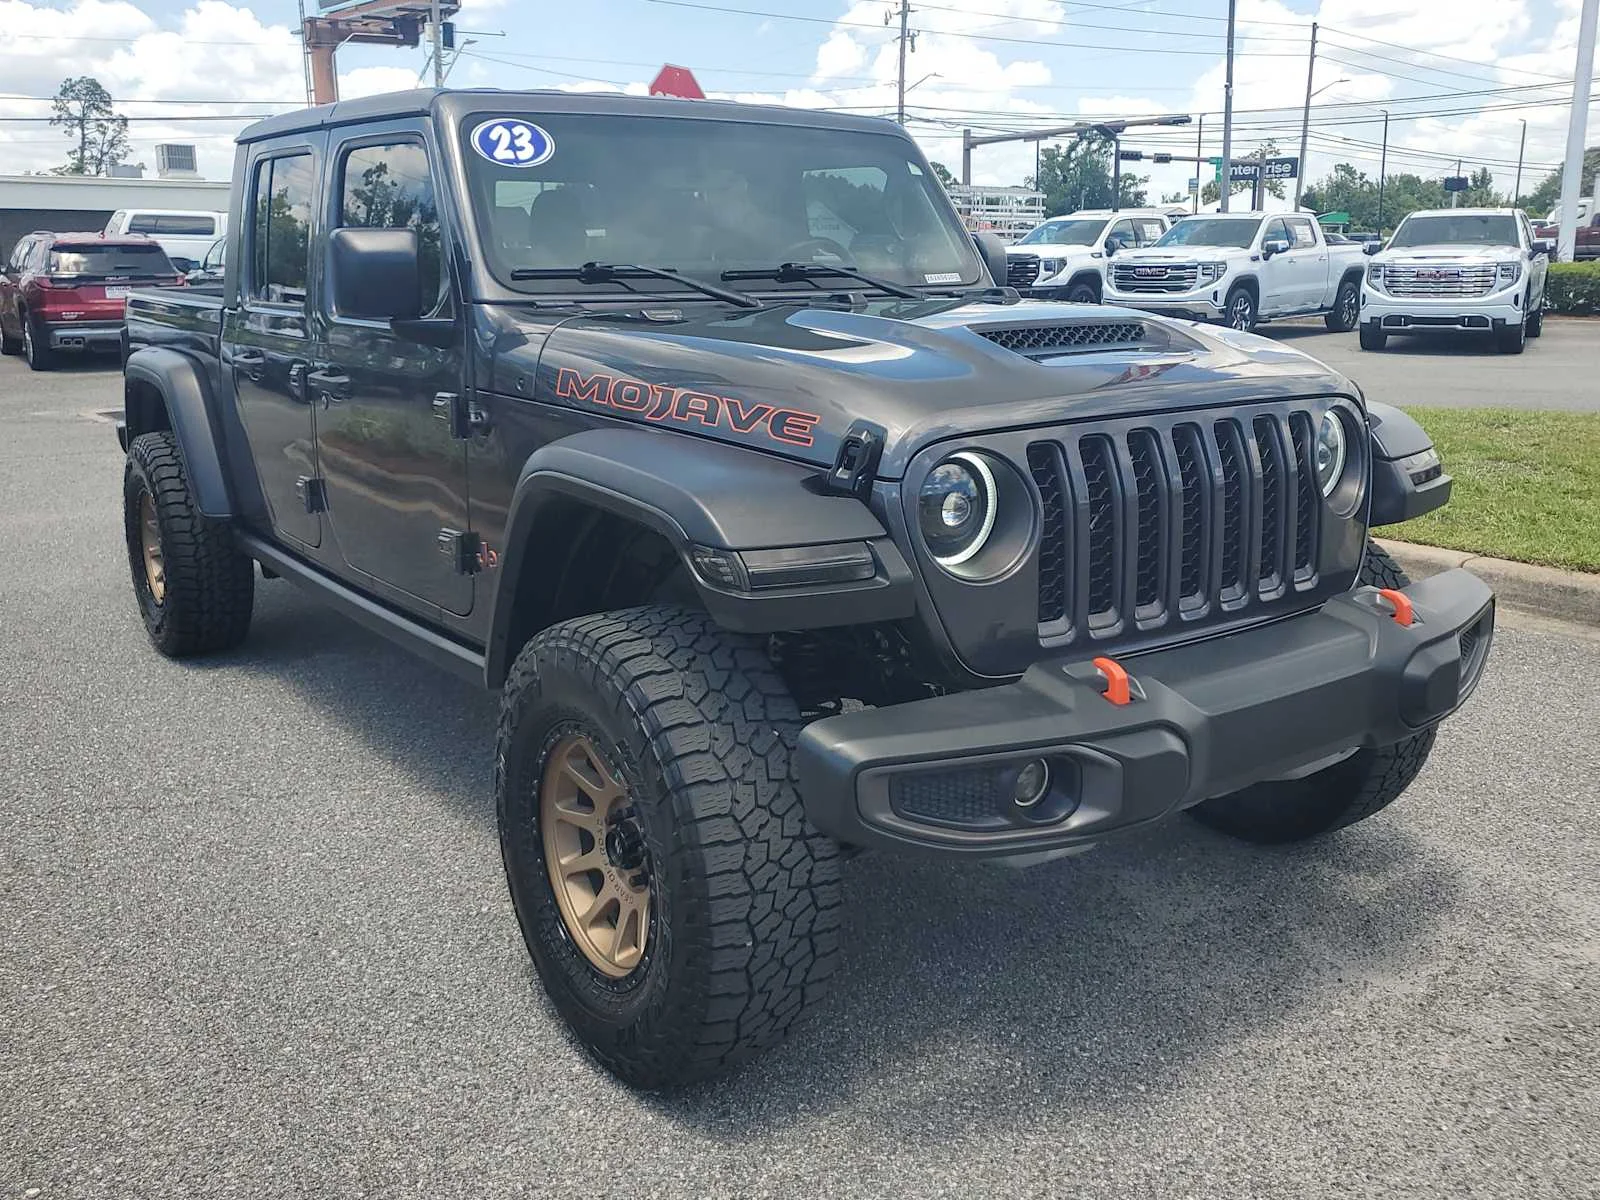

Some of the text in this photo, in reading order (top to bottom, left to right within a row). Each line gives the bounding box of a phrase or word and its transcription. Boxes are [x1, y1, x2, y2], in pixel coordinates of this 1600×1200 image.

[488, 124, 535, 161] 23
[1220, 161, 1293, 178] nterrise
[1135, 267, 1166, 276] GMC
[1417, 269, 1460, 280] GMC
[556, 367, 821, 447] MOJAVE
